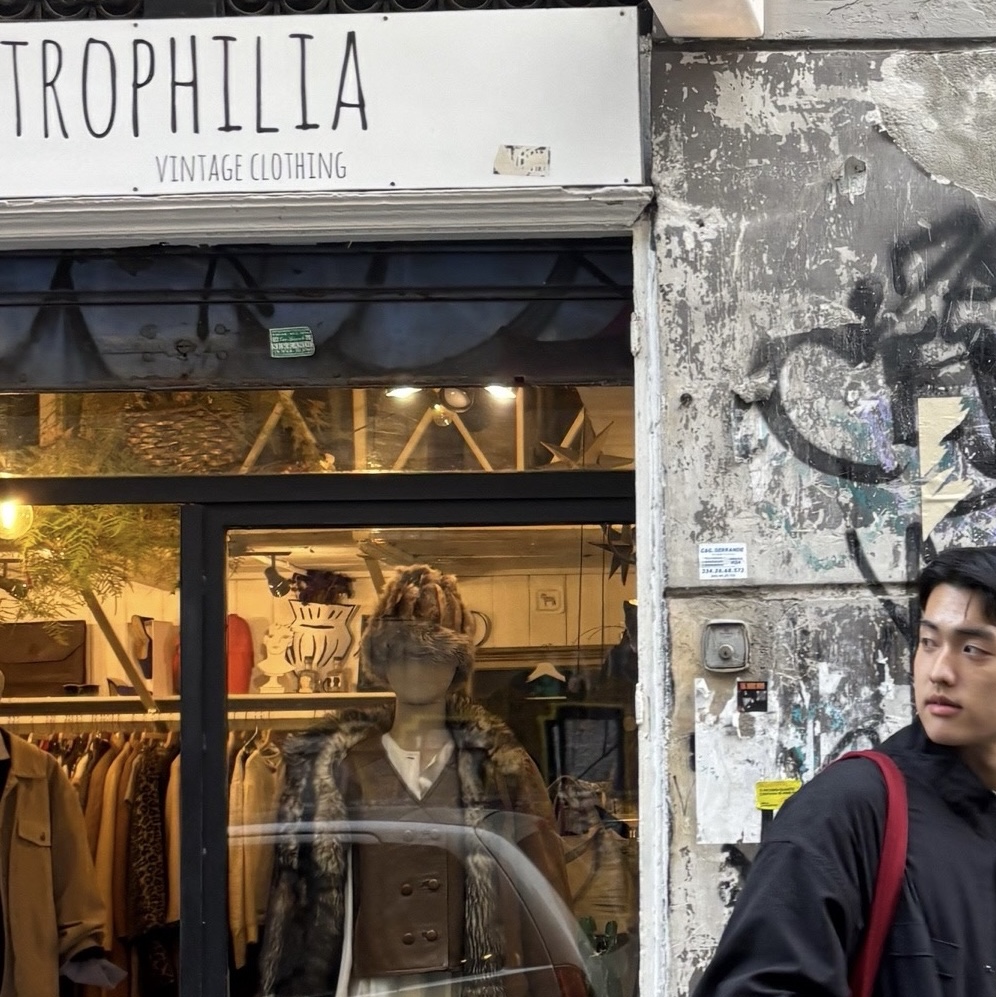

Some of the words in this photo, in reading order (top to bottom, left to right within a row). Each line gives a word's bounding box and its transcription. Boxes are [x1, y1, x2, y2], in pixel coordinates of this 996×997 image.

[0, 31, 368, 139] TROPHILIA
[156, 154, 243, 183] VINTAGE
[250, 152, 347, 181] CLOTHING
